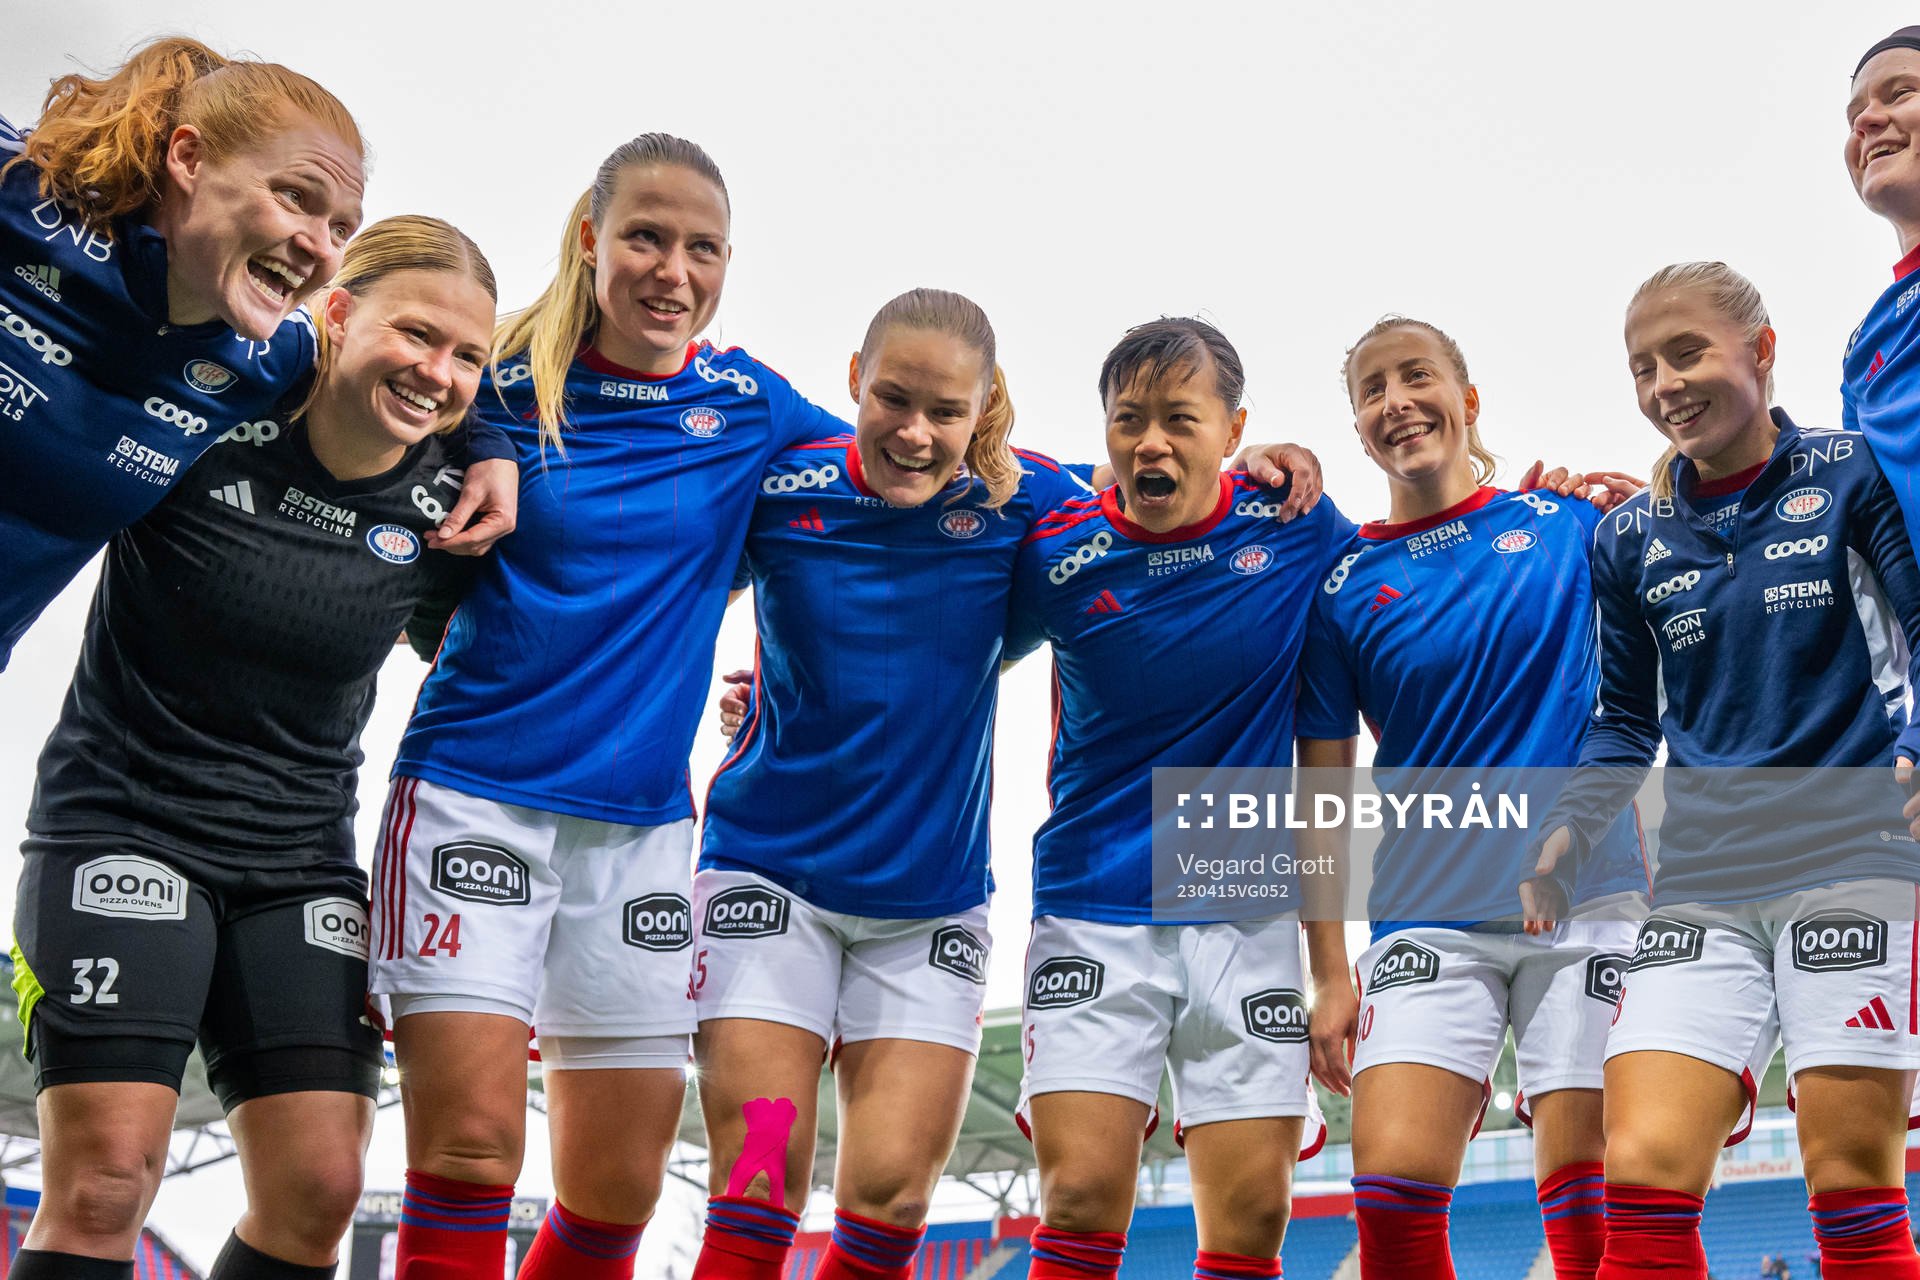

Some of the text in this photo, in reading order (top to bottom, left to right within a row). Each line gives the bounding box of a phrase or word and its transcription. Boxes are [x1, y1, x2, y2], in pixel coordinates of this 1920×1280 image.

[31, 198, 113, 262] DNB
[14, 264, 62, 303] adidas
[495, 364, 533, 388] co
[694, 356, 756, 396] coop
[0, 373, 37, 408] ON
[617, 383, 669, 400] STENA
[144, 396, 208, 437] coop
[215, 420, 280, 447] op
[106, 452, 171, 487] RECYCLING
[131, 444, 180, 477] STENA
[1790, 436, 1854, 477] DNB
[763, 464, 840, 495] coop
[300, 495, 357, 527] STENA
[1235, 501, 1285, 519] coo
[1510, 493, 1560, 517] op
[1615, 496, 1675, 537] DNB
[1716, 502, 1741, 522] STE
[278, 502, 353, 539] RECYCLING
[1422, 519, 1469, 548] STENA
[1049, 531, 1113, 586] coop
[1163, 544, 1213, 565] STENA
[1411, 534, 1473, 561] RECYCLING
[1764, 534, 1829, 561] coop
[1646, 569, 1701, 605] coop
[1779, 579, 1833, 601] STENA
[1766, 596, 1835, 615] RECYCLING
[1662, 608, 1707, 641] THON
[1671, 629, 1706, 654] HOTELS
[446, 856, 520, 890] ooni
[89, 873, 174, 902] ooni
[455, 881, 511, 897] PIZZA OVENS
[99, 897, 163, 909] PIZZA OVENS
[713, 899, 778, 923] ooni
[321, 913, 369, 941] oon
[635, 908, 689, 933] ooni
[717, 921, 765, 930] PIZZA OVENS
[332, 936, 355, 945] PIZZA
[419, 913, 462, 958] 24
[664, 933, 684, 941] OVENS
[1801, 926, 1874, 953] ooni
[944, 938, 985, 971] ooni
[1374, 951, 1427, 981] ooni
[1808, 952, 1862, 962] PIZZA OVENS
[70, 957, 120, 1004] 32
[1034, 968, 1092, 995] ooni
[1391, 970, 1415, 979] OVENS
[1609, 989, 1621, 997] PIZ
